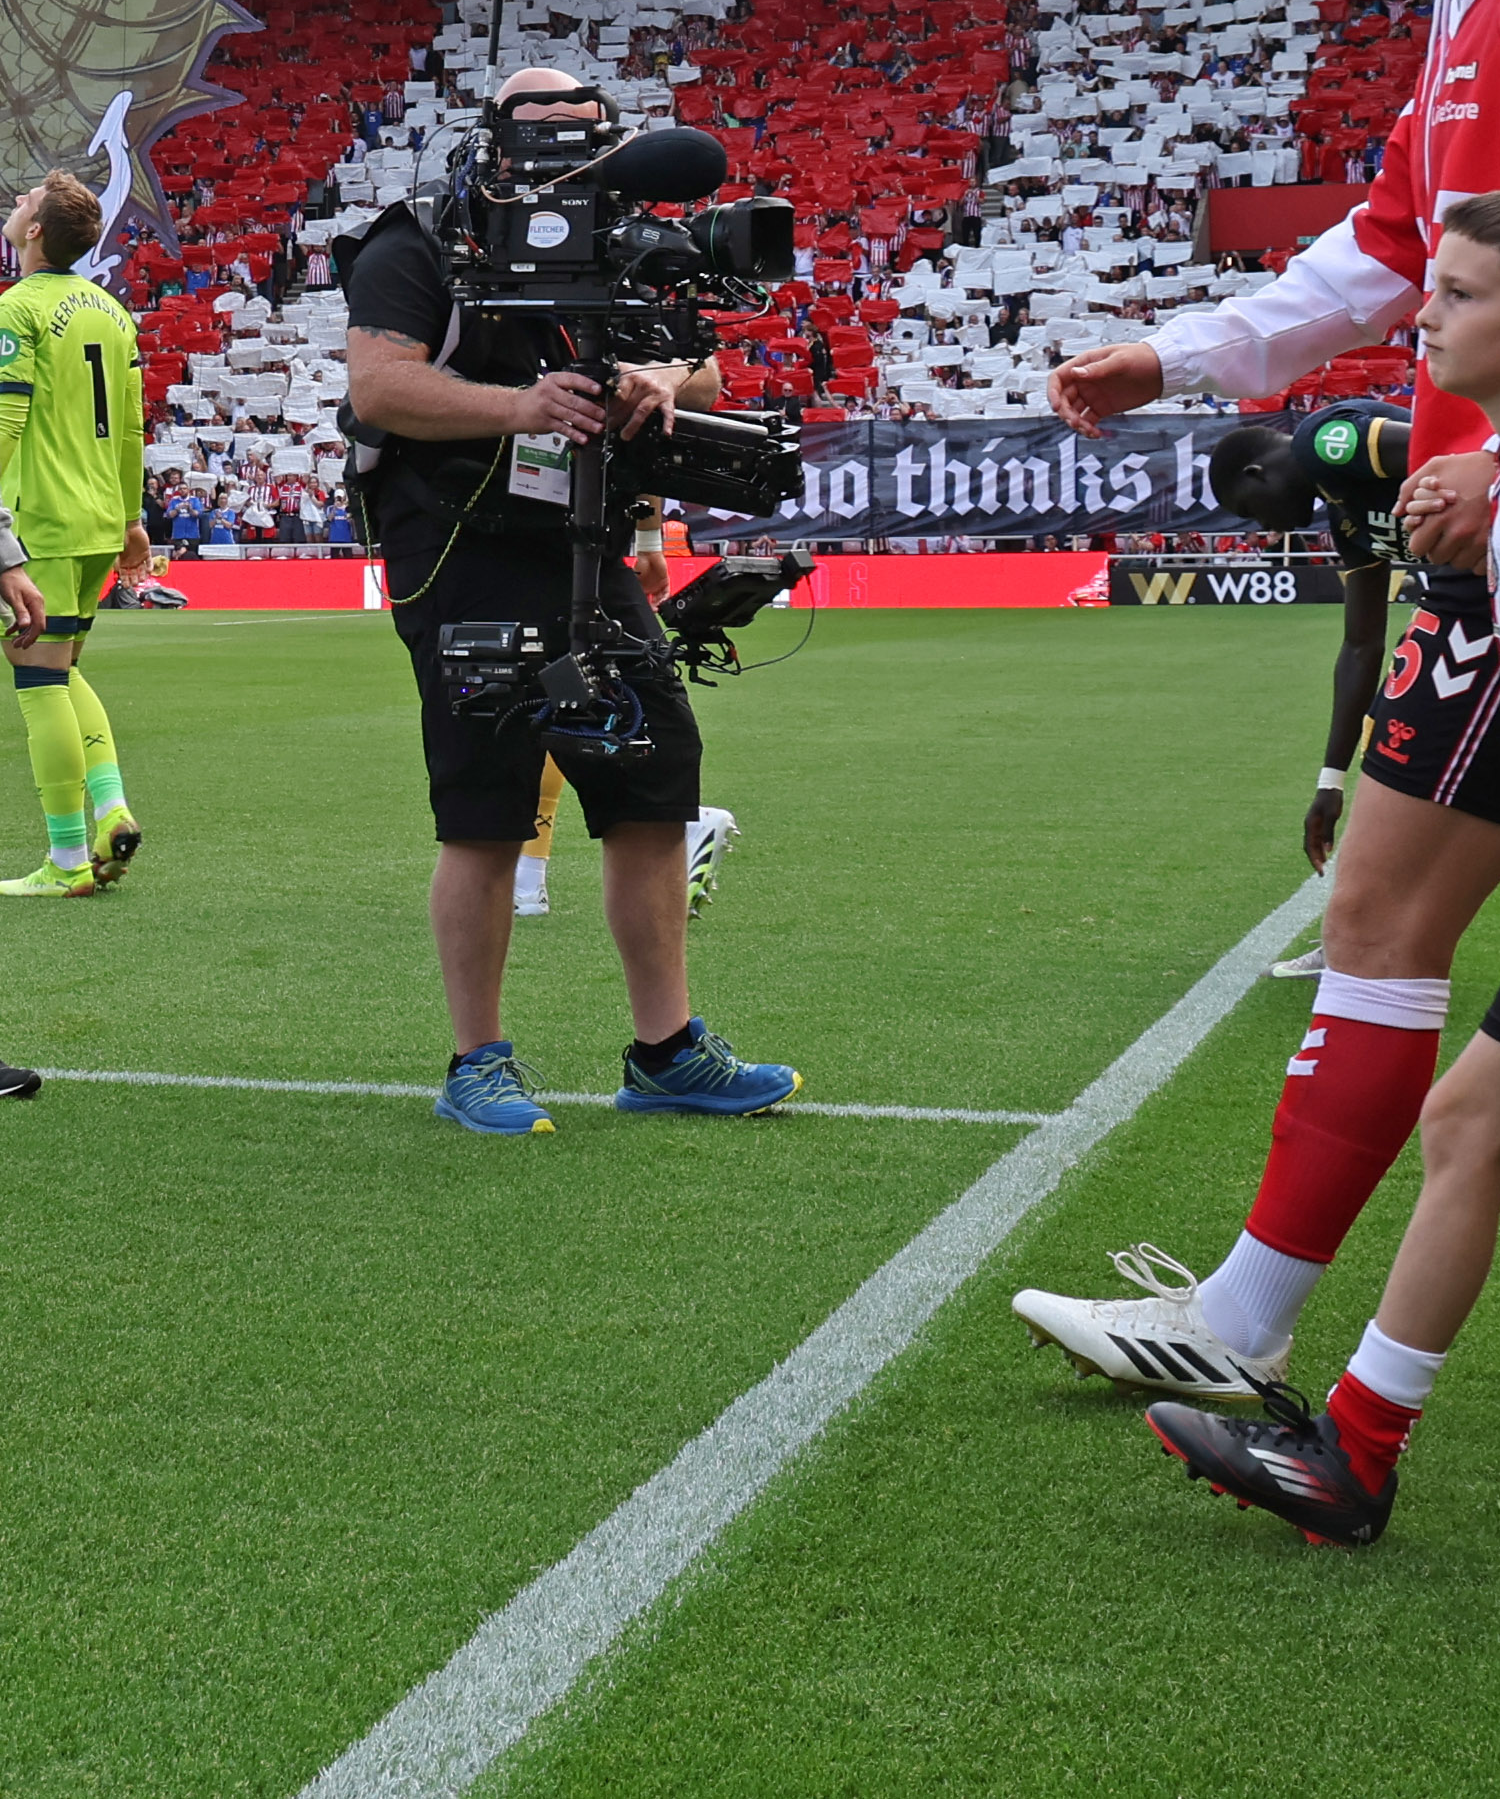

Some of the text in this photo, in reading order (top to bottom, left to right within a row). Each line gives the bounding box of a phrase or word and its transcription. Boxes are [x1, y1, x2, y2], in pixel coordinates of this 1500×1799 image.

[529, 226, 565, 234] FLETCHER
[50, 291, 127, 339] HERMANSEN
[84, 344, 109, 439] 1
[892, 433, 1153, 517] thinks
[1207, 570, 1297, 604] W88
